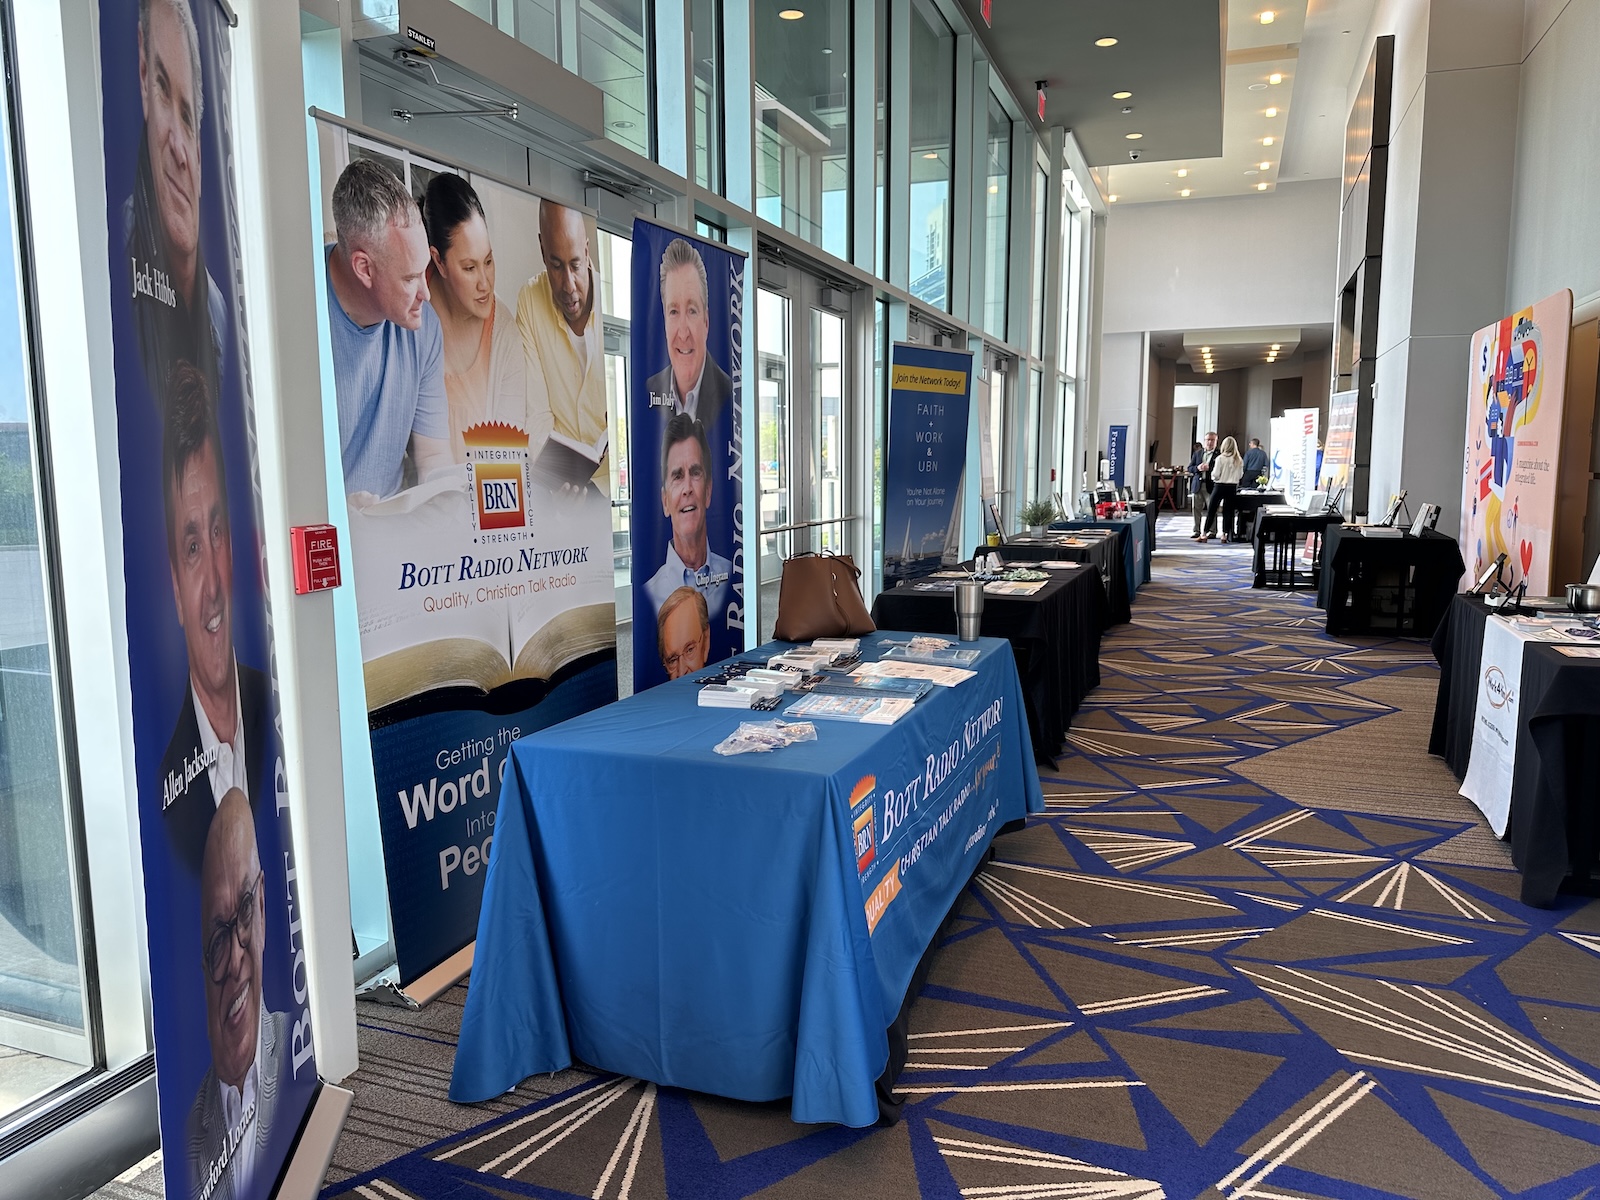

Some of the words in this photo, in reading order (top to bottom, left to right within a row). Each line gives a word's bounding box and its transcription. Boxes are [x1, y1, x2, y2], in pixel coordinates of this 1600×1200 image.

[408, 29, 435, 48] STANLEY
[131, 256, 154, 298] Jack
[153, 267, 177, 308] Hibbs
[896, 373, 909, 385] Join
[909, 373, 919, 384] the
[920, 377, 943, 387] Network
[943, 378, 962, 390] Today!
[648, 391, 662, 409] Jim
[917, 403, 945, 416] FAITH
[915, 431, 944, 444] WORK
[1109, 430, 1118, 476] Freedom
[474, 450, 521, 460] INTEGRITY
[918, 460, 938, 473] UBN
[466, 462, 477, 531] QUALITY
[483, 482, 517, 510] BRN
[525, 462, 534, 527] SERVICE
[906, 499, 914, 507] on
[914, 498, 926, 507] Your
[926, 498, 945, 508] Journey
[933, 487, 946, 496] Alone
[310, 538, 333, 550] FIRE
[481, 532, 528, 545] STRENGTH
[398, 562, 455, 591] BOTT
[458, 555, 514, 582] RADIO
[516, 546, 589, 573] NETWORK
[423, 591, 474, 613] Quality,
[476, 582, 526, 604] Christian
[528, 578, 548, 594] Talk
[549, 572, 577, 590] Radio
[436, 735, 494, 770] Getting
[498, 726, 521, 746] the
[162, 769, 184, 811] Allen
[183, 746, 217, 795] Jackson
[398, 756, 491, 830] Word
[881, 773, 922, 844] BOTT
[923, 740, 959, 801] RADIO
[466, 810, 496, 838] Into
[857, 822, 872, 858] BRN
[901, 821, 938, 876] CHRISTIAN
[938, 803, 953, 832] TALK
[199, 1137, 229, 1200] wford
